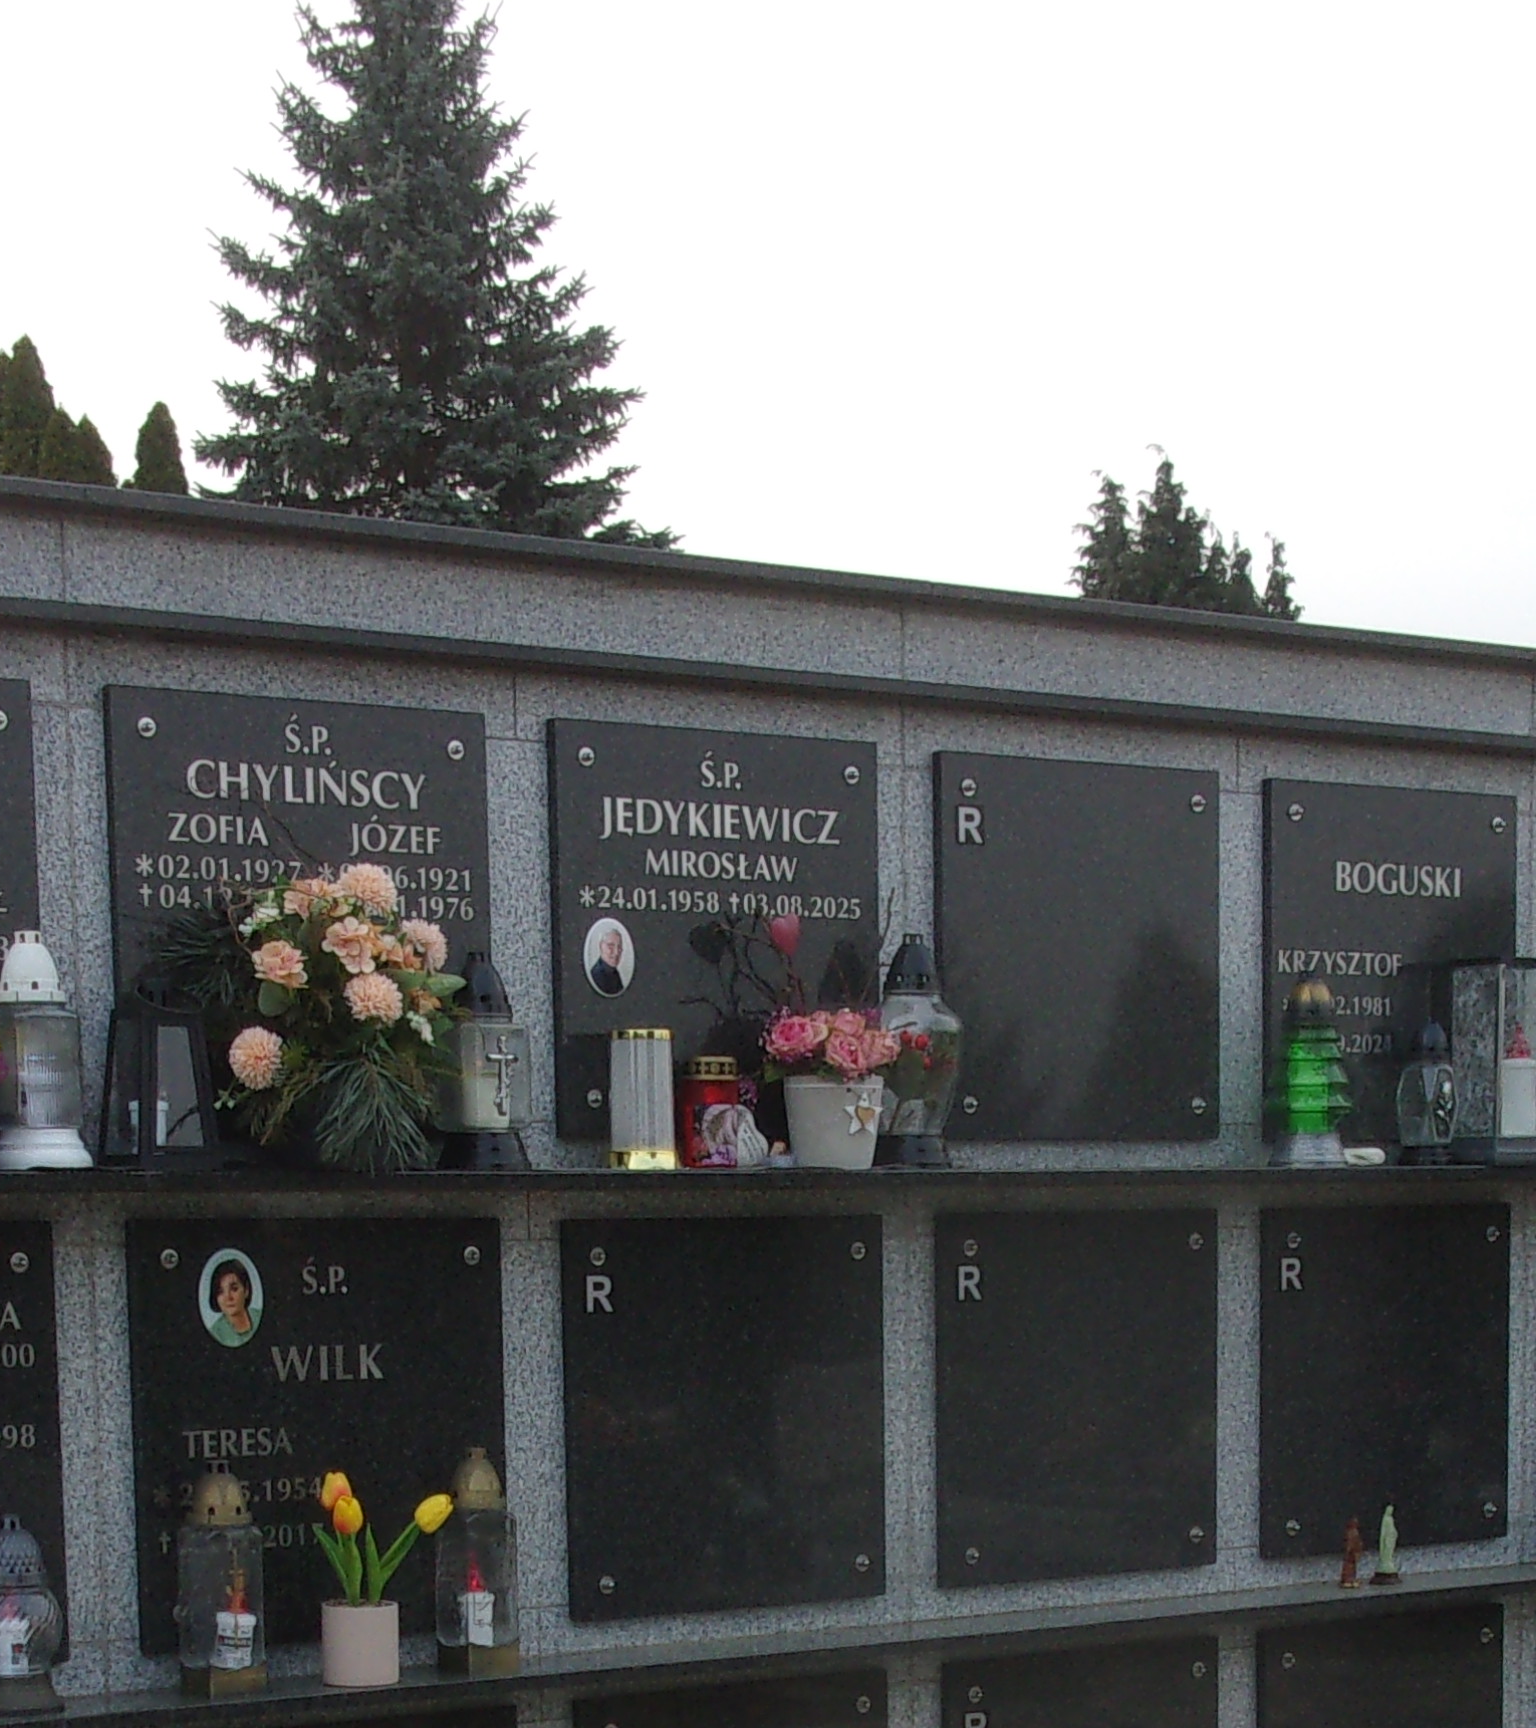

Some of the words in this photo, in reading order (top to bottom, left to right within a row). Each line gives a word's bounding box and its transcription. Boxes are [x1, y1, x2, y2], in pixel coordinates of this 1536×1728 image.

[284, 714, 332, 756] Ś.P.
[186, 760, 426, 811] CHYLIŃSCY
[700, 751, 742, 790] Ś.P.
[167, 813, 269, 847] ZOFIA
[350, 815, 442, 857] JÓZEF
[599, 796, 841, 846] JĘDYKIEWICZ
[957, 806, 984, 844] R
[645, 848, 798, 882] MIROSŁAW
[1336, 861, 1462, 897] BOGUSKI
[1277, 949, 1402, 977] KRZYSZTOF
[302, 1257, 349, 1295] Ś.P.
[957, 1265, 983, 1301] R
[1280, 1257, 1304, 1291] R
[586, 1274, 613, 1313] R
[271, 1343, 384, 1383] WILK
[183, 1427, 293, 1459] TERESA
